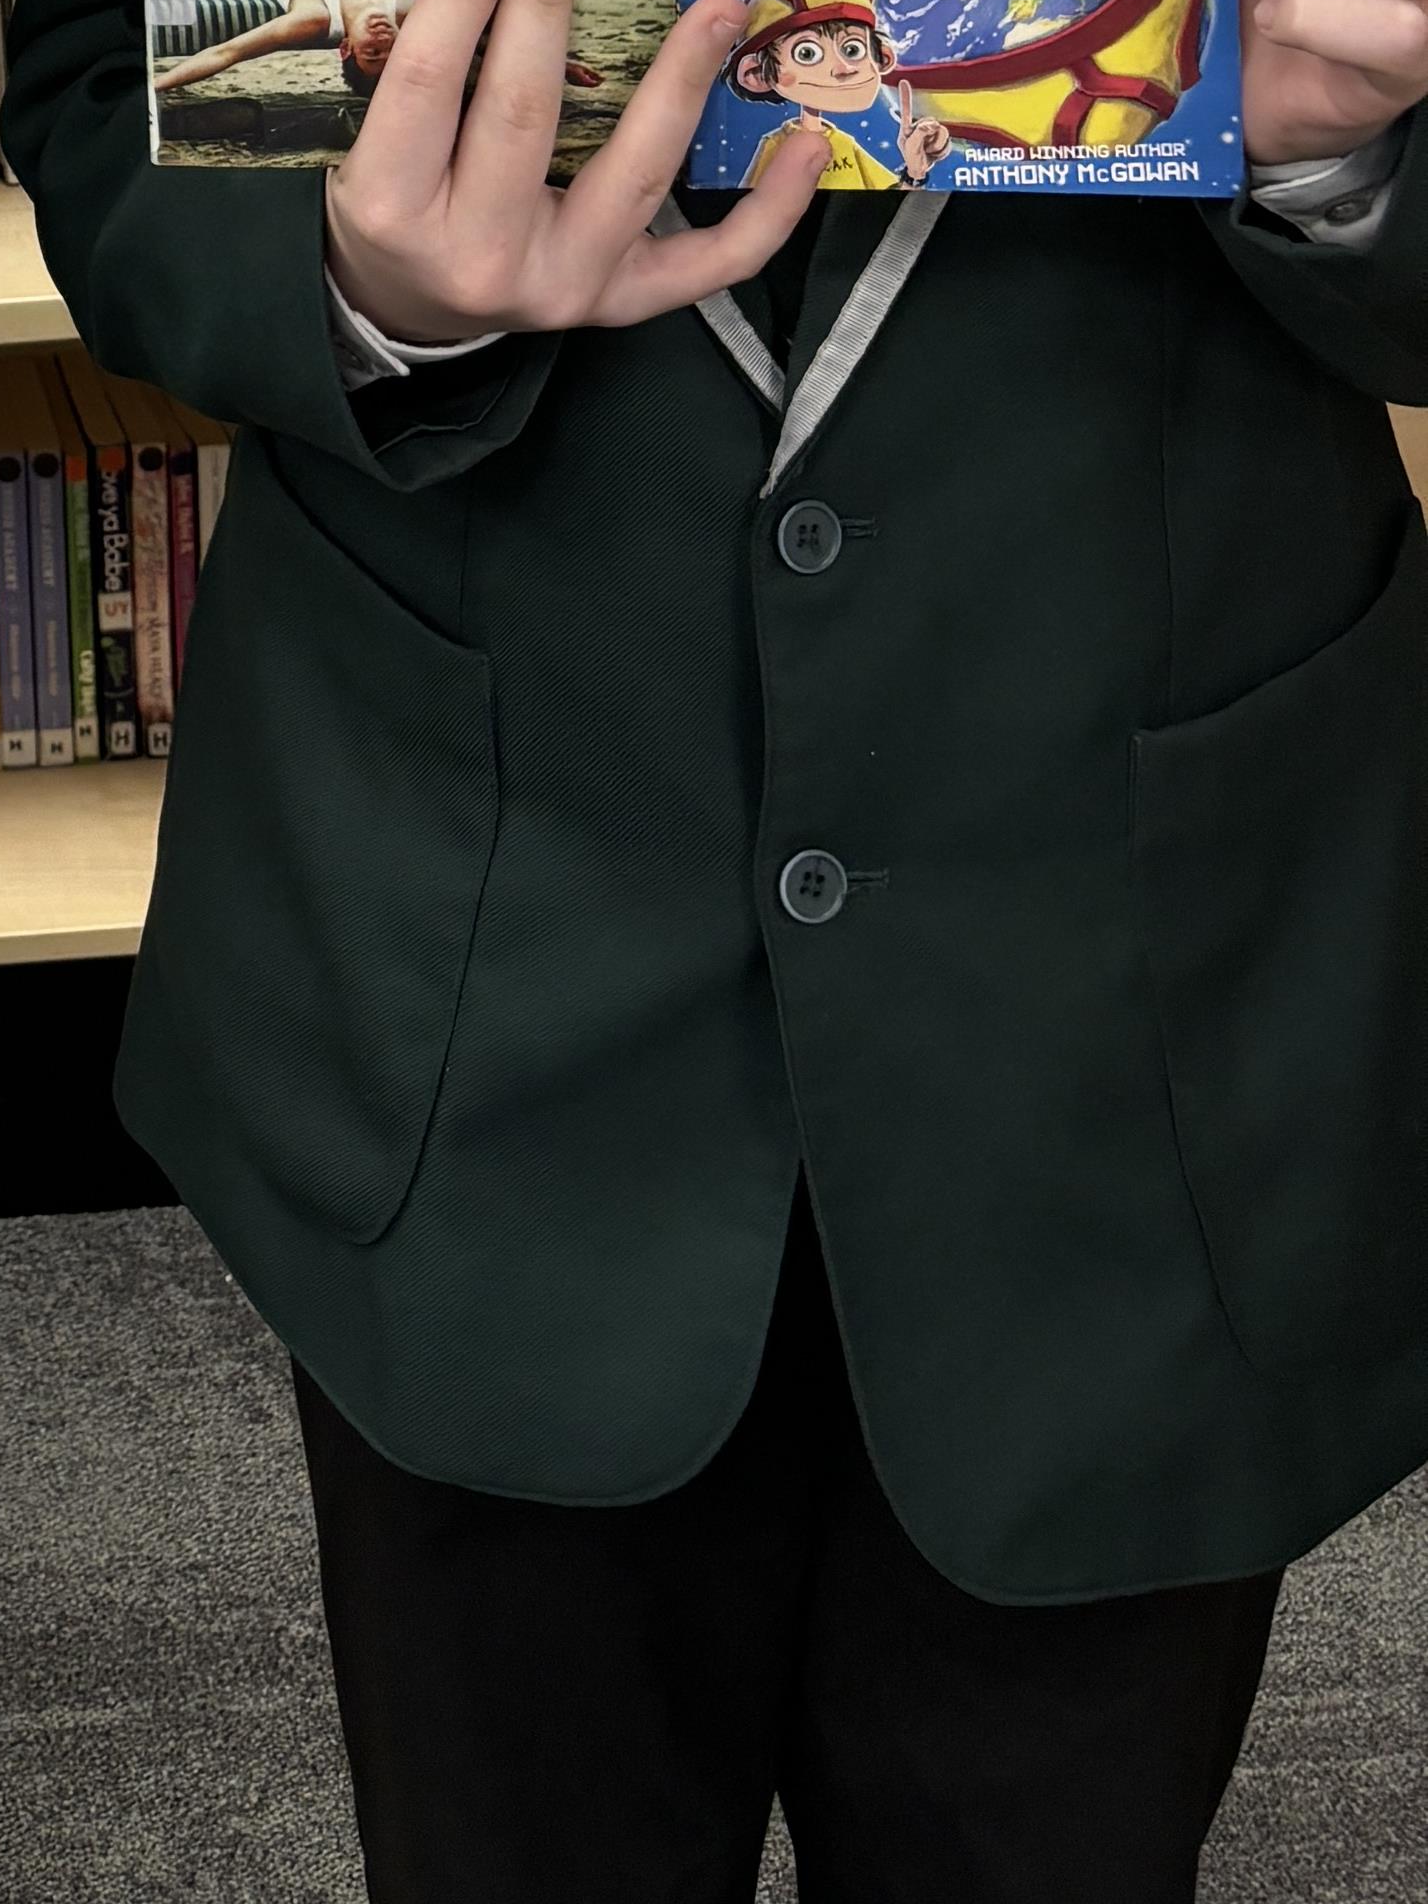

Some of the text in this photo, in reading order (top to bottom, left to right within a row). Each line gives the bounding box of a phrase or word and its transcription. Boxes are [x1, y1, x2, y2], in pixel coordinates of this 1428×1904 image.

[965, 142, 1185, 162] AWARD WINNING AUTHOR
[955, 161, 1199, 186] ANTHONY McGOWAN
